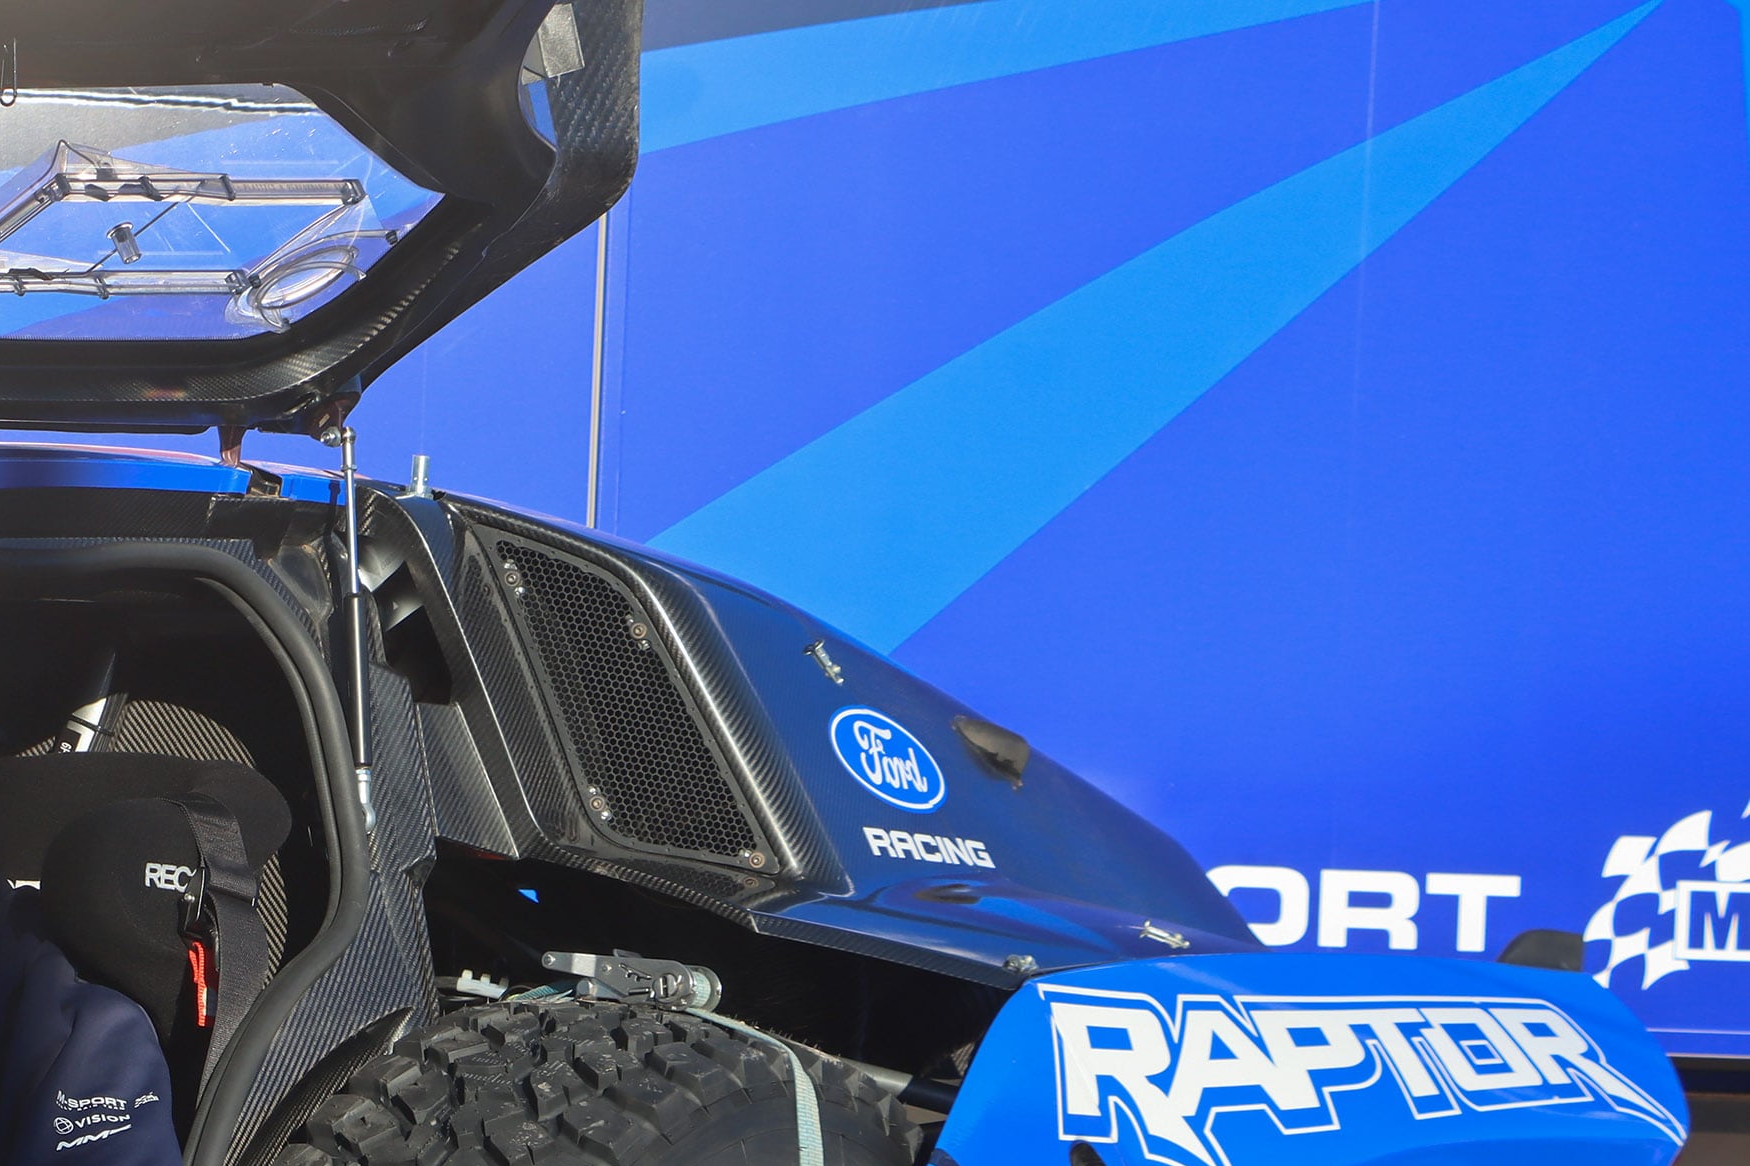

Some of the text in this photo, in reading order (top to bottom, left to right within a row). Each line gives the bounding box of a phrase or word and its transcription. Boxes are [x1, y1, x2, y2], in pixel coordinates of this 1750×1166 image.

[853, 720, 928, 793] Ford
[862, 826, 996, 869] RACING
[75, 1114, 130, 1128] VISION
